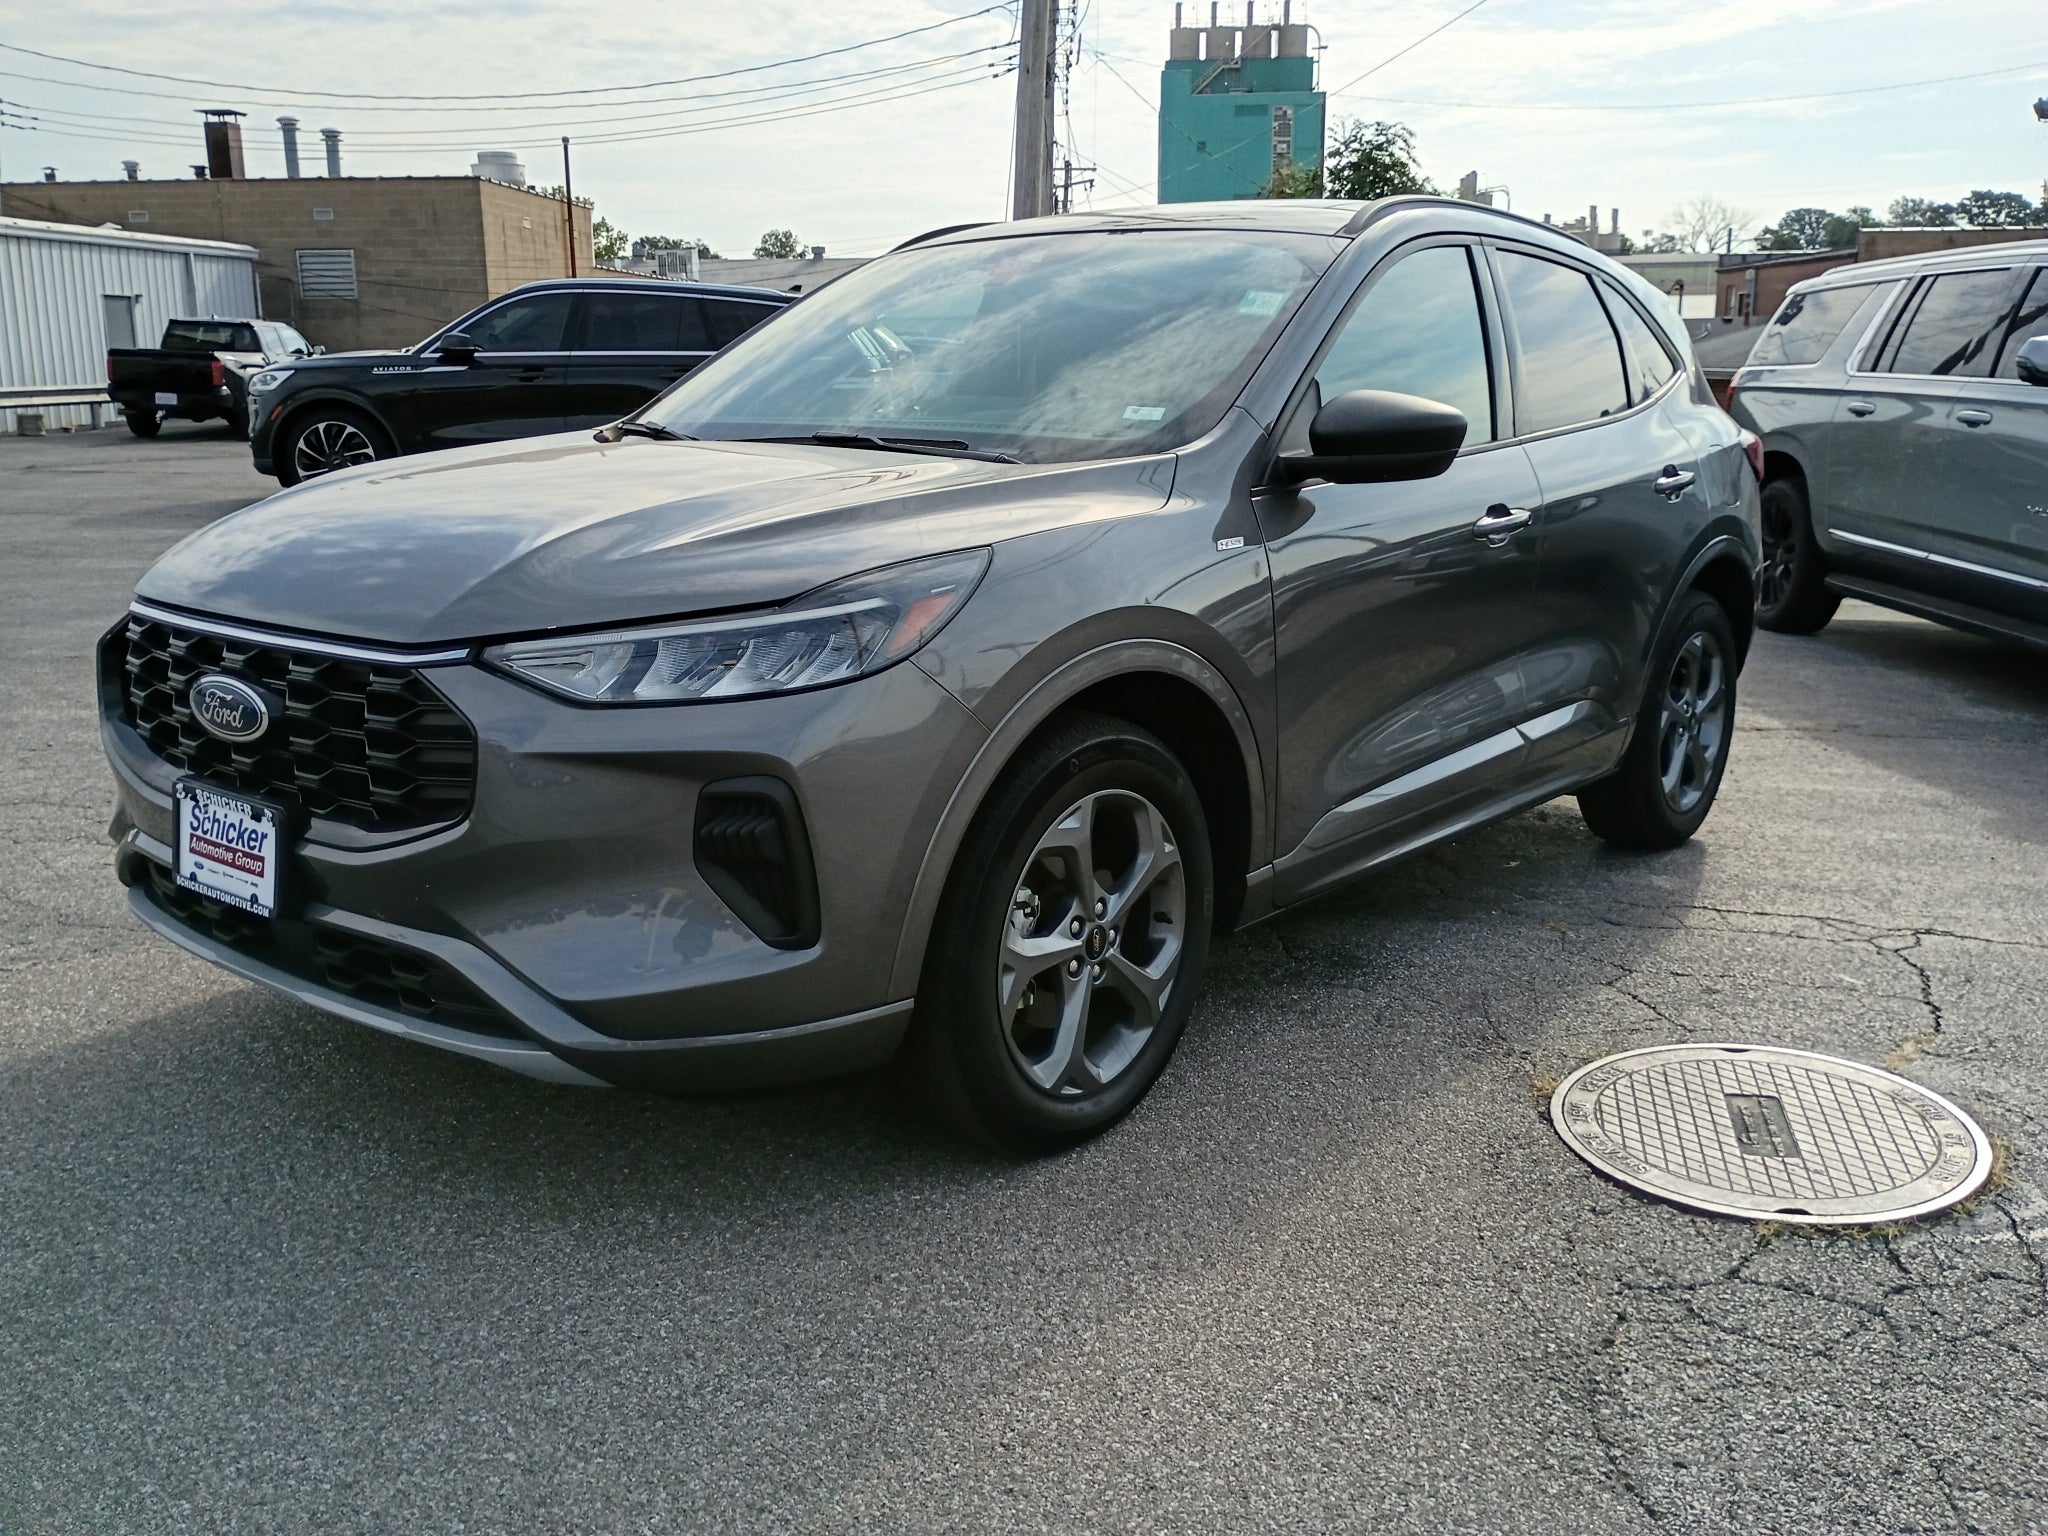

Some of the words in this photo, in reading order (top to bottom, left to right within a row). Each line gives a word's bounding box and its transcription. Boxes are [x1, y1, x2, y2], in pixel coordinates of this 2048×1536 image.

[202, 688, 243, 728] Ford
[195, 788, 251, 816] SCHICKER
[190, 803, 268, 853] Schicker
[190, 837, 234, 863] Automotive
[235, 852, 263, 875] Group
[176, 875, 270, 918] SCHICKERAUTOMOTIVE.COM
